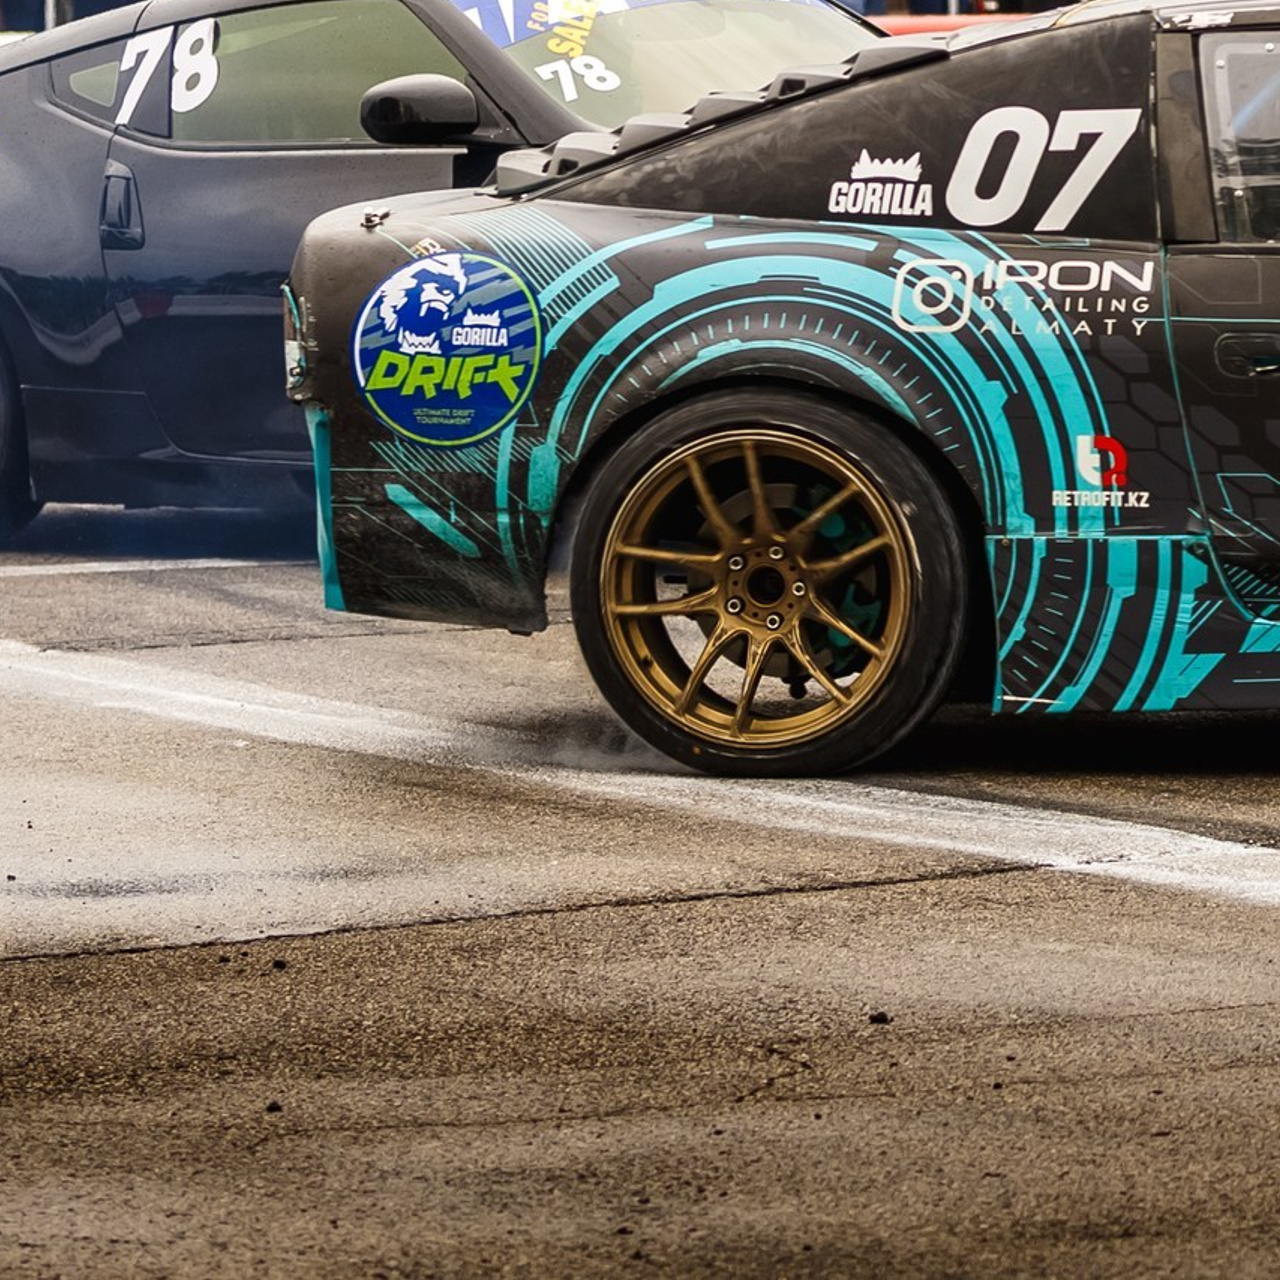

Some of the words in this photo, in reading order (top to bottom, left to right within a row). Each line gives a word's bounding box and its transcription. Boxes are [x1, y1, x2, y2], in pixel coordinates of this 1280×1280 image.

[115, 18, 219, 125] 78
[534, 54, 621, 103] 78
[945, 106, 1143, 232] 07
[828, 181, 933, 217] GORILLA
[982, 260, 1155, 292] IRON
[980, 295, 1150, 313] DETAILING
[452, 326, 509, 347] GORILLA
[980, 319, 1149, 336] ALMATY
[1052, 490, 1150, 507] RETROFIT.KZ
